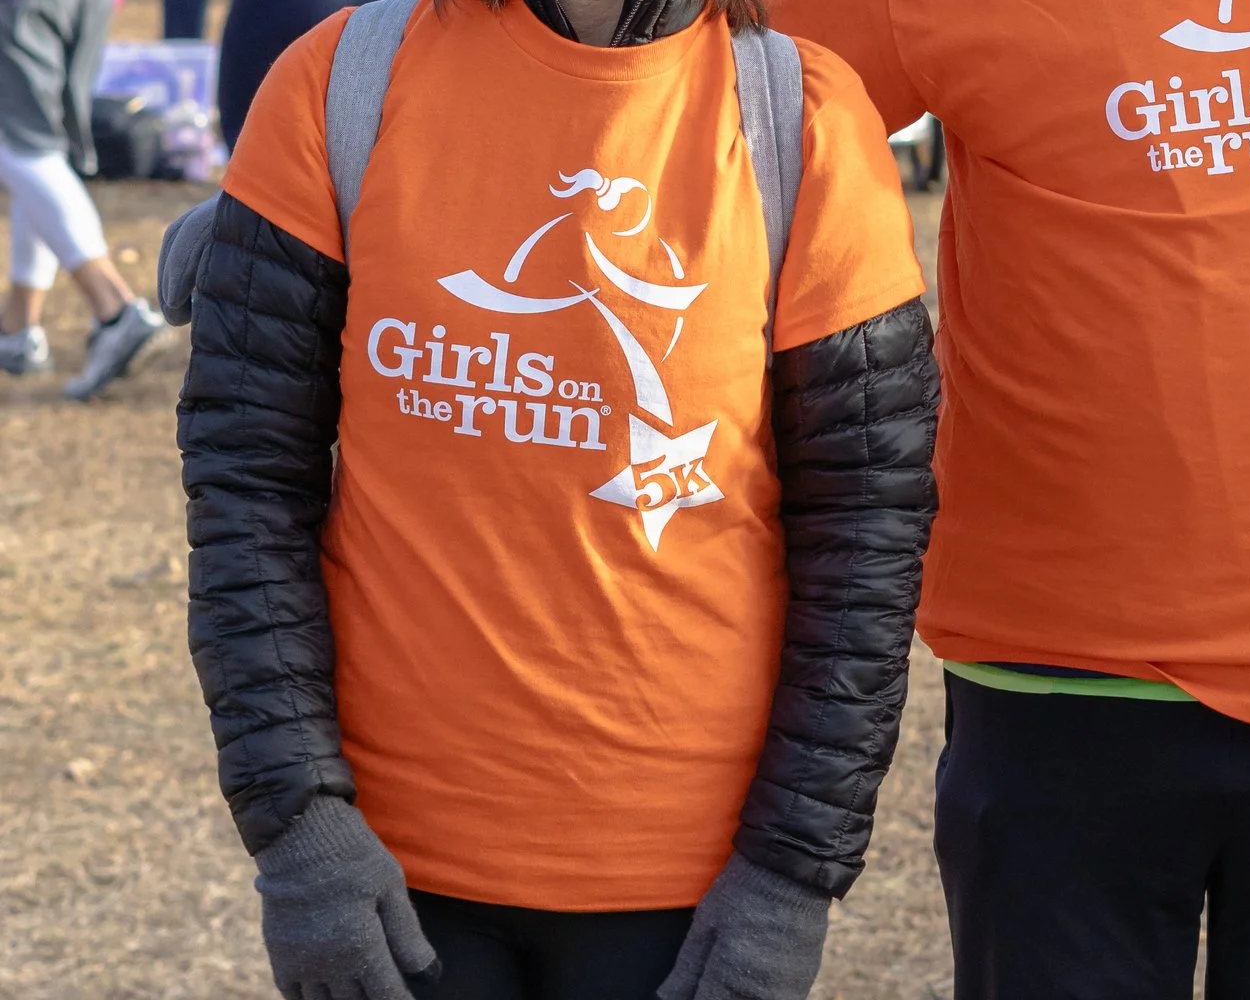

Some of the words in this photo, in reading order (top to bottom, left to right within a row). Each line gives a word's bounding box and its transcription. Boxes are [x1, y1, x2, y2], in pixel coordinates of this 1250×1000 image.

[1146, 142, 1203, 172] the
[367, 317, 555, 397] Girls
[558, 377, 603, 402] on
[396, 388, 452, 422] the
[631, 454, 711, 512] 5K
